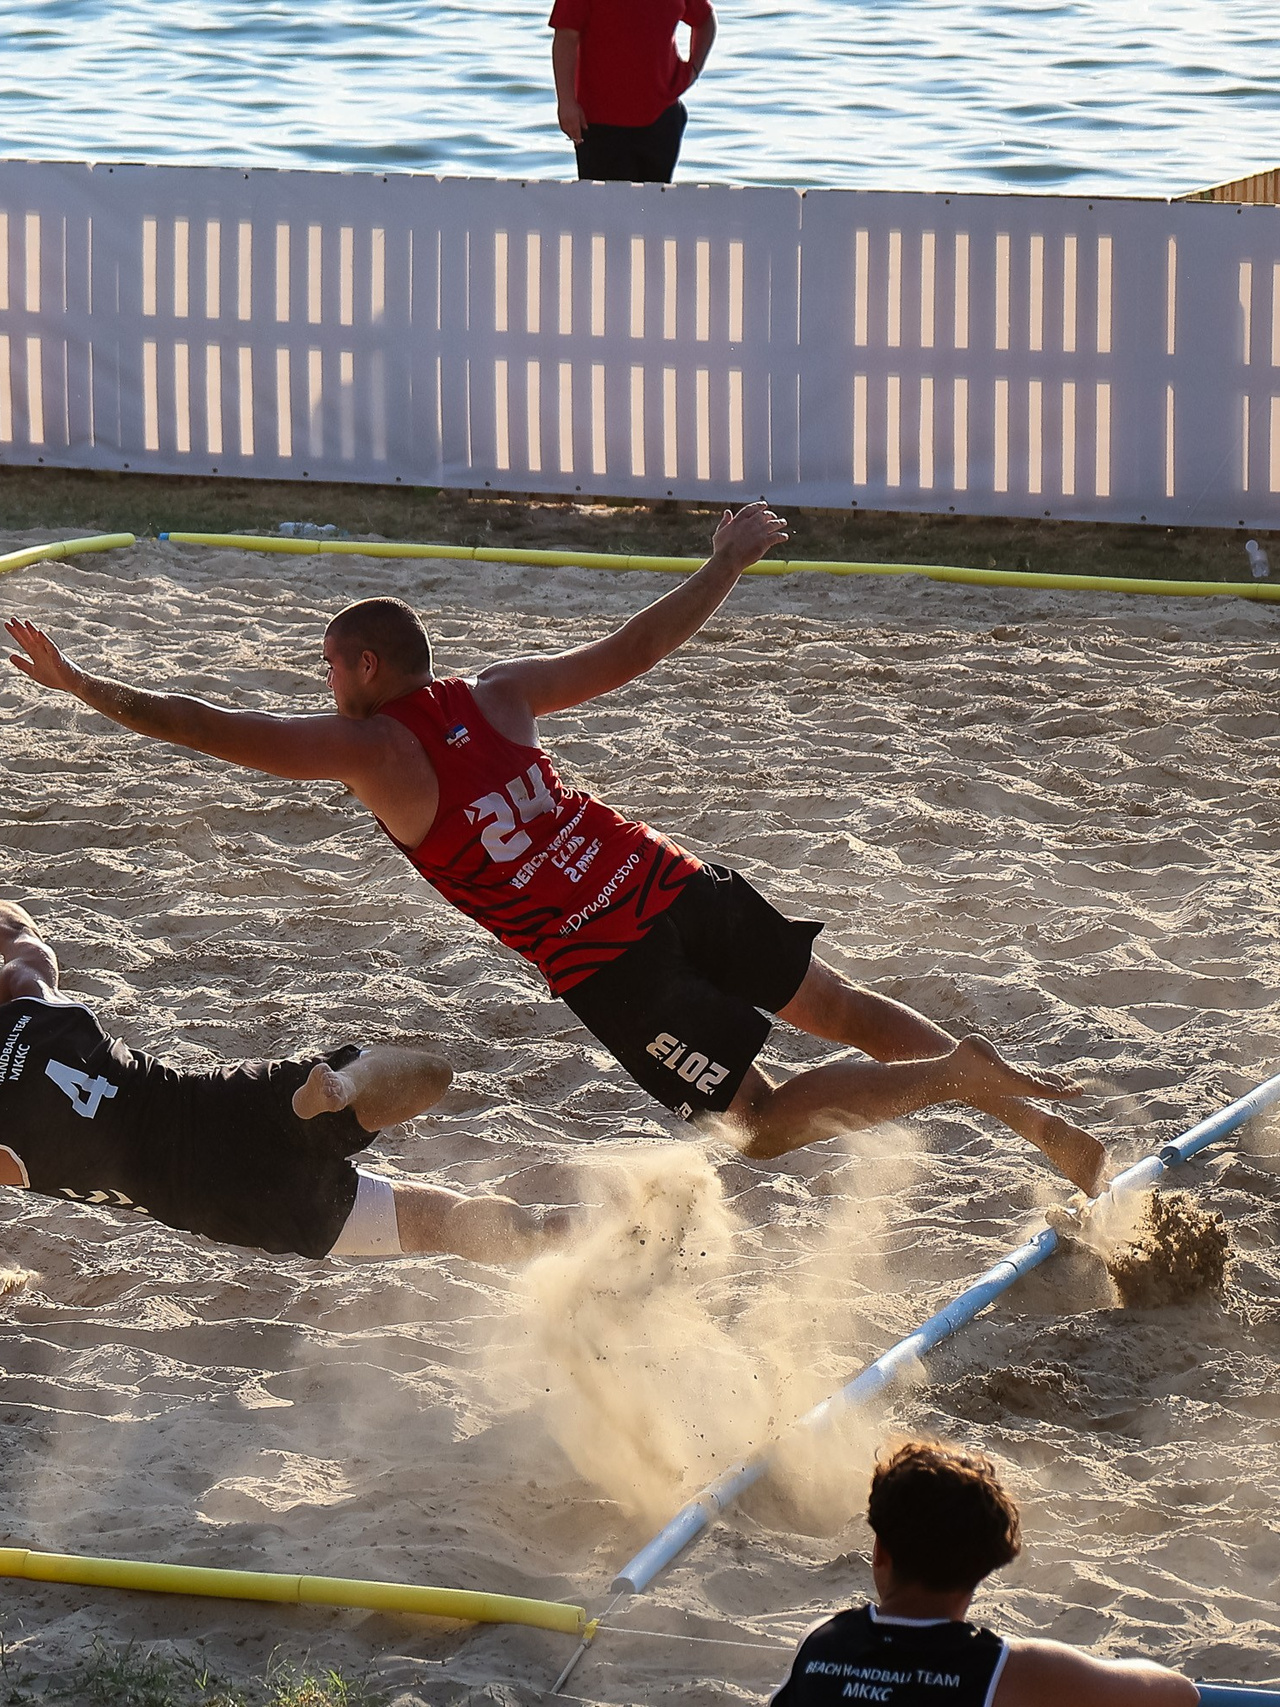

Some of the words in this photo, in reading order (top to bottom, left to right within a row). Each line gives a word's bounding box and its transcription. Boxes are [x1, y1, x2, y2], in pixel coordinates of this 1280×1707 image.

[464, 763, 564, 863] 24
[564, 866, 583, 883] 2
[13, 1015, 33, 1034] TEAM
[9, 1043, 31, 1081] MKKC
[646, 1032, 731, 1096] 2013
[45, 1058, 119, 1119] 4
[806, 1660, 842, 1676] BEACH
[917, 1670, 961, 1688] TEAM
[843, 1682, 894, 1701] MKKC
